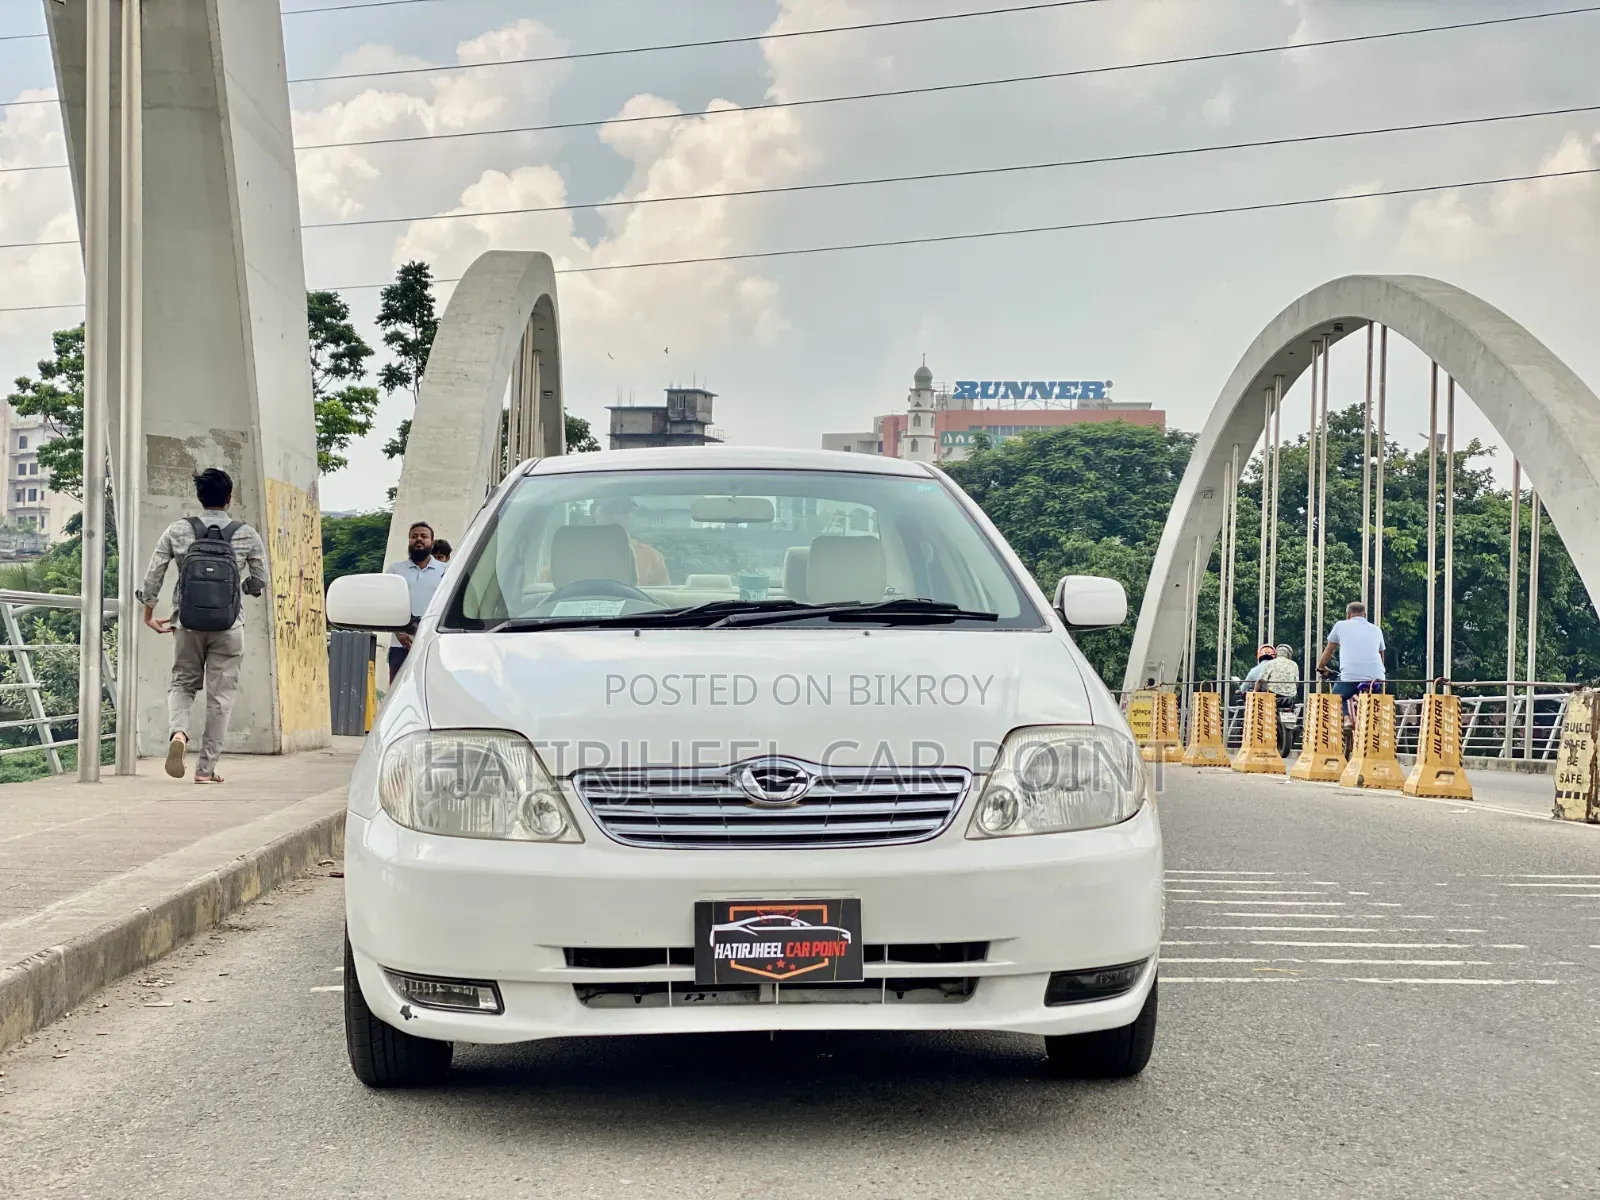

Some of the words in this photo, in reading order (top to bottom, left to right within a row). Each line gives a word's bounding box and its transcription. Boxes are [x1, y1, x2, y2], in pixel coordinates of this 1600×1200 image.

[952, 380, 1106, 400] RUNNER
[1264, 701, 1272, 740] STEEL
[1321, 698, 1329, 749] JULFIKAR
[1330, 702, 1338, 745] STEEL
[1382, 704, 1391, 749] STEEL
[1434, 699, 1443, 760] JULFIKAR
[1444, 705, 1455, 754] STEEL
[1564, 722, 1591, 734] BUILD
[1559, 773, 1583, 784] SAFE
[715, 942, 784, 959] HATIRJHEEL
[786, 941, 810, 957] CAR
[811, 940, 848, 957] POINT
